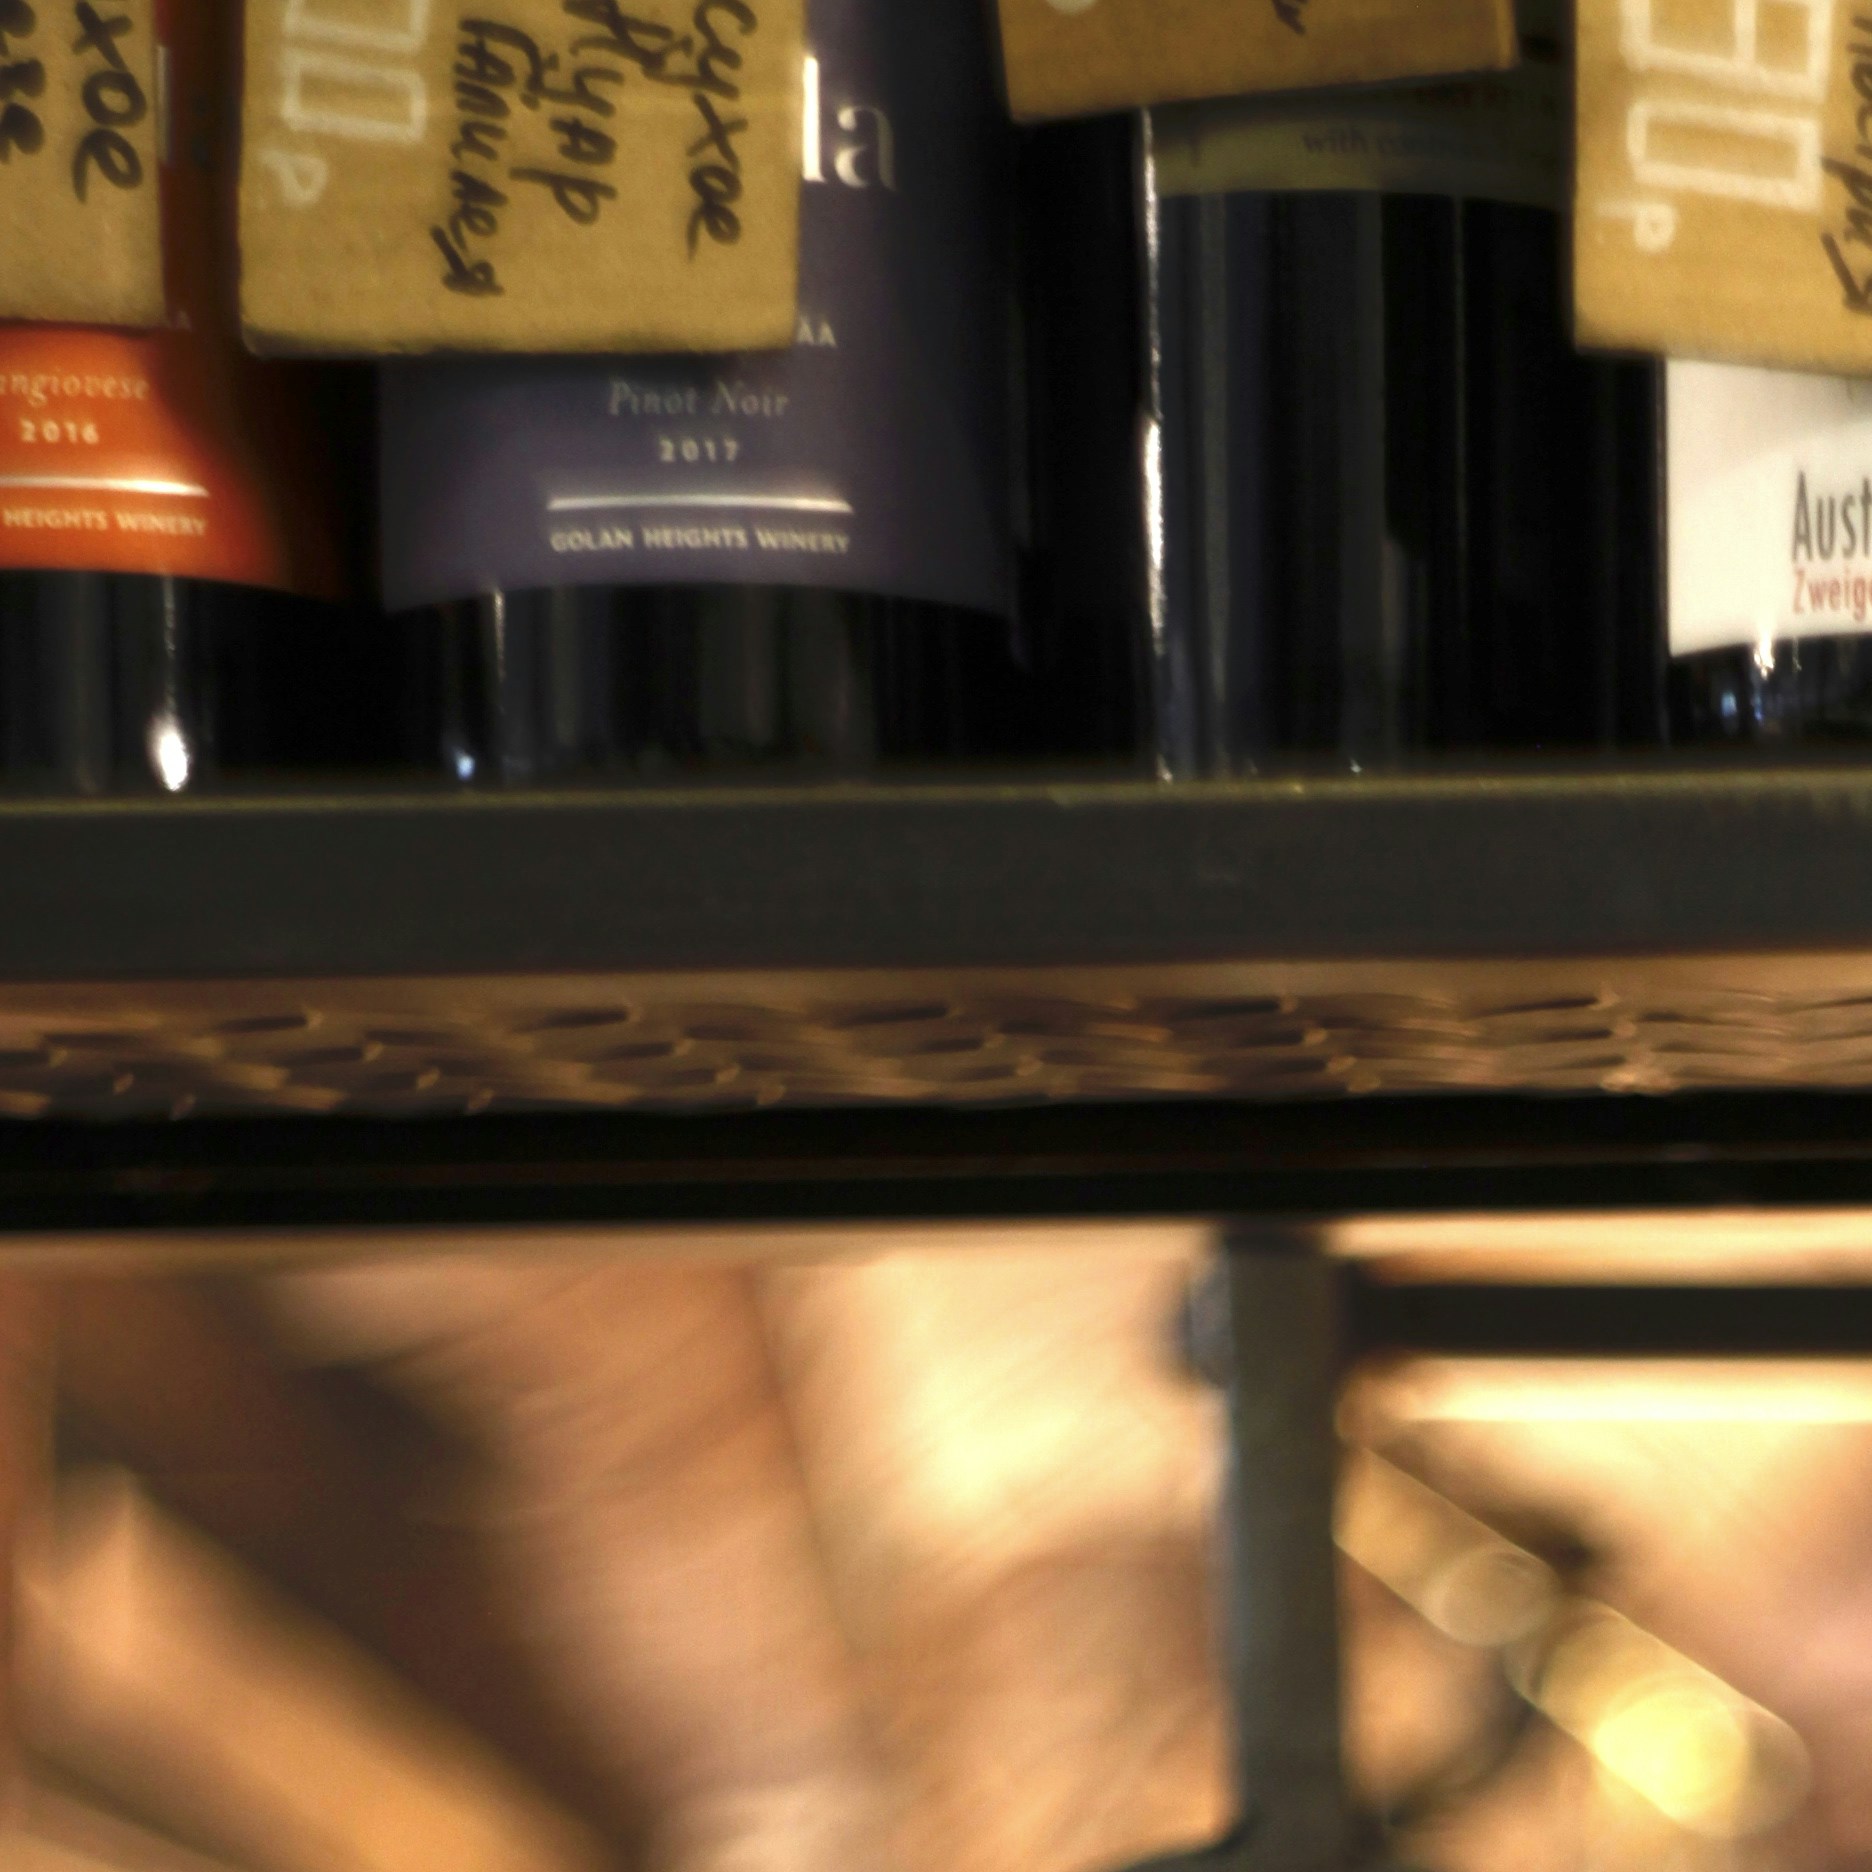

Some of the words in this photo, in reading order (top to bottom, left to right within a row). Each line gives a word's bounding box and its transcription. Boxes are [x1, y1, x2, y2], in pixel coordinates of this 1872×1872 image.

[430, 16, 544, 297] Галилея
[0, 372, 150, 408] ngiovese
[608, 377, 699, 418] Pinot
[712, 378, 790, 419] Noir
[20, 417, 99, 445] 2016
[658, 433, 740, 464] 2017
[2, 507, 109, 531] HEIGHTS
[114, 510, 207, 537] WINERY
[550, 526, 635, 554] GOLAN
[642, 524, 748, 552] HEIGHTS
[754, 526, 850, 555] WINERY
